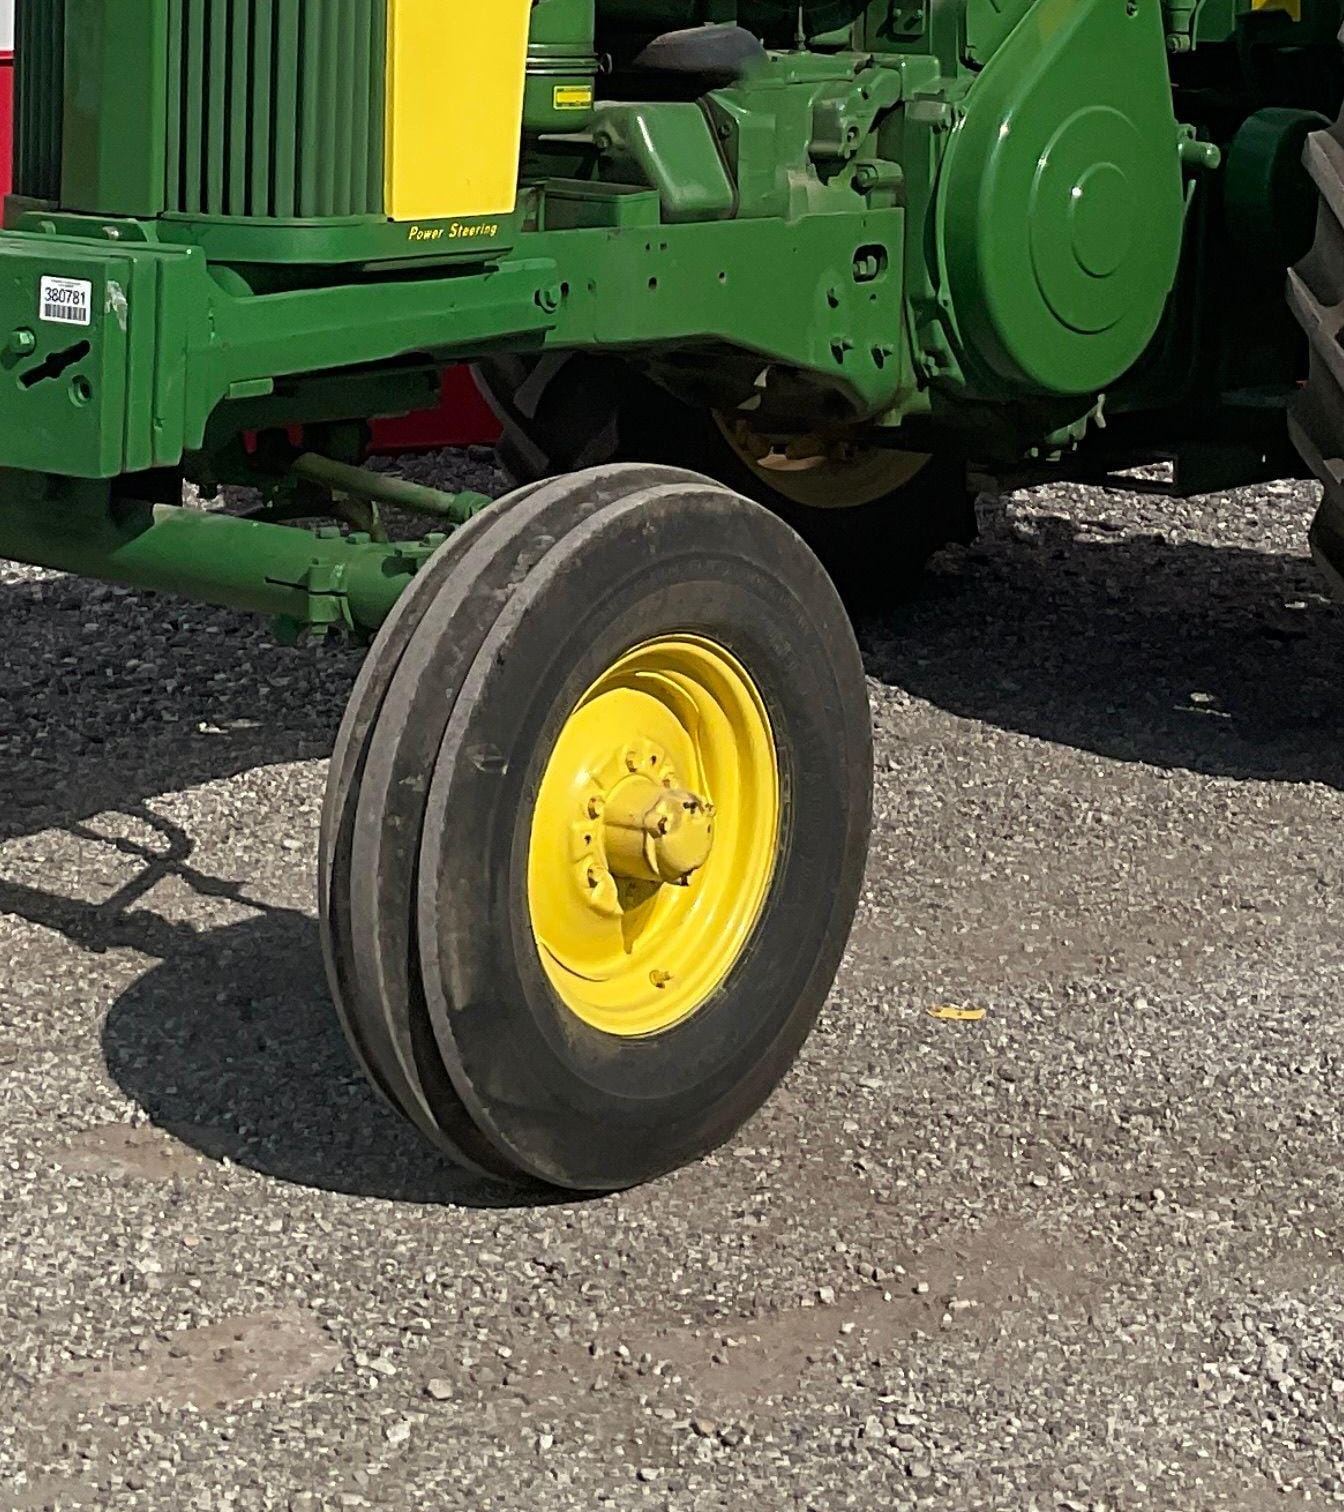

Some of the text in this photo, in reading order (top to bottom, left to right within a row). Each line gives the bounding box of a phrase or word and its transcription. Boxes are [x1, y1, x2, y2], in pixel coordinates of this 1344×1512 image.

[408, 222, 498, 240] Power Steering
[45, 287, 86, 305] 380781
